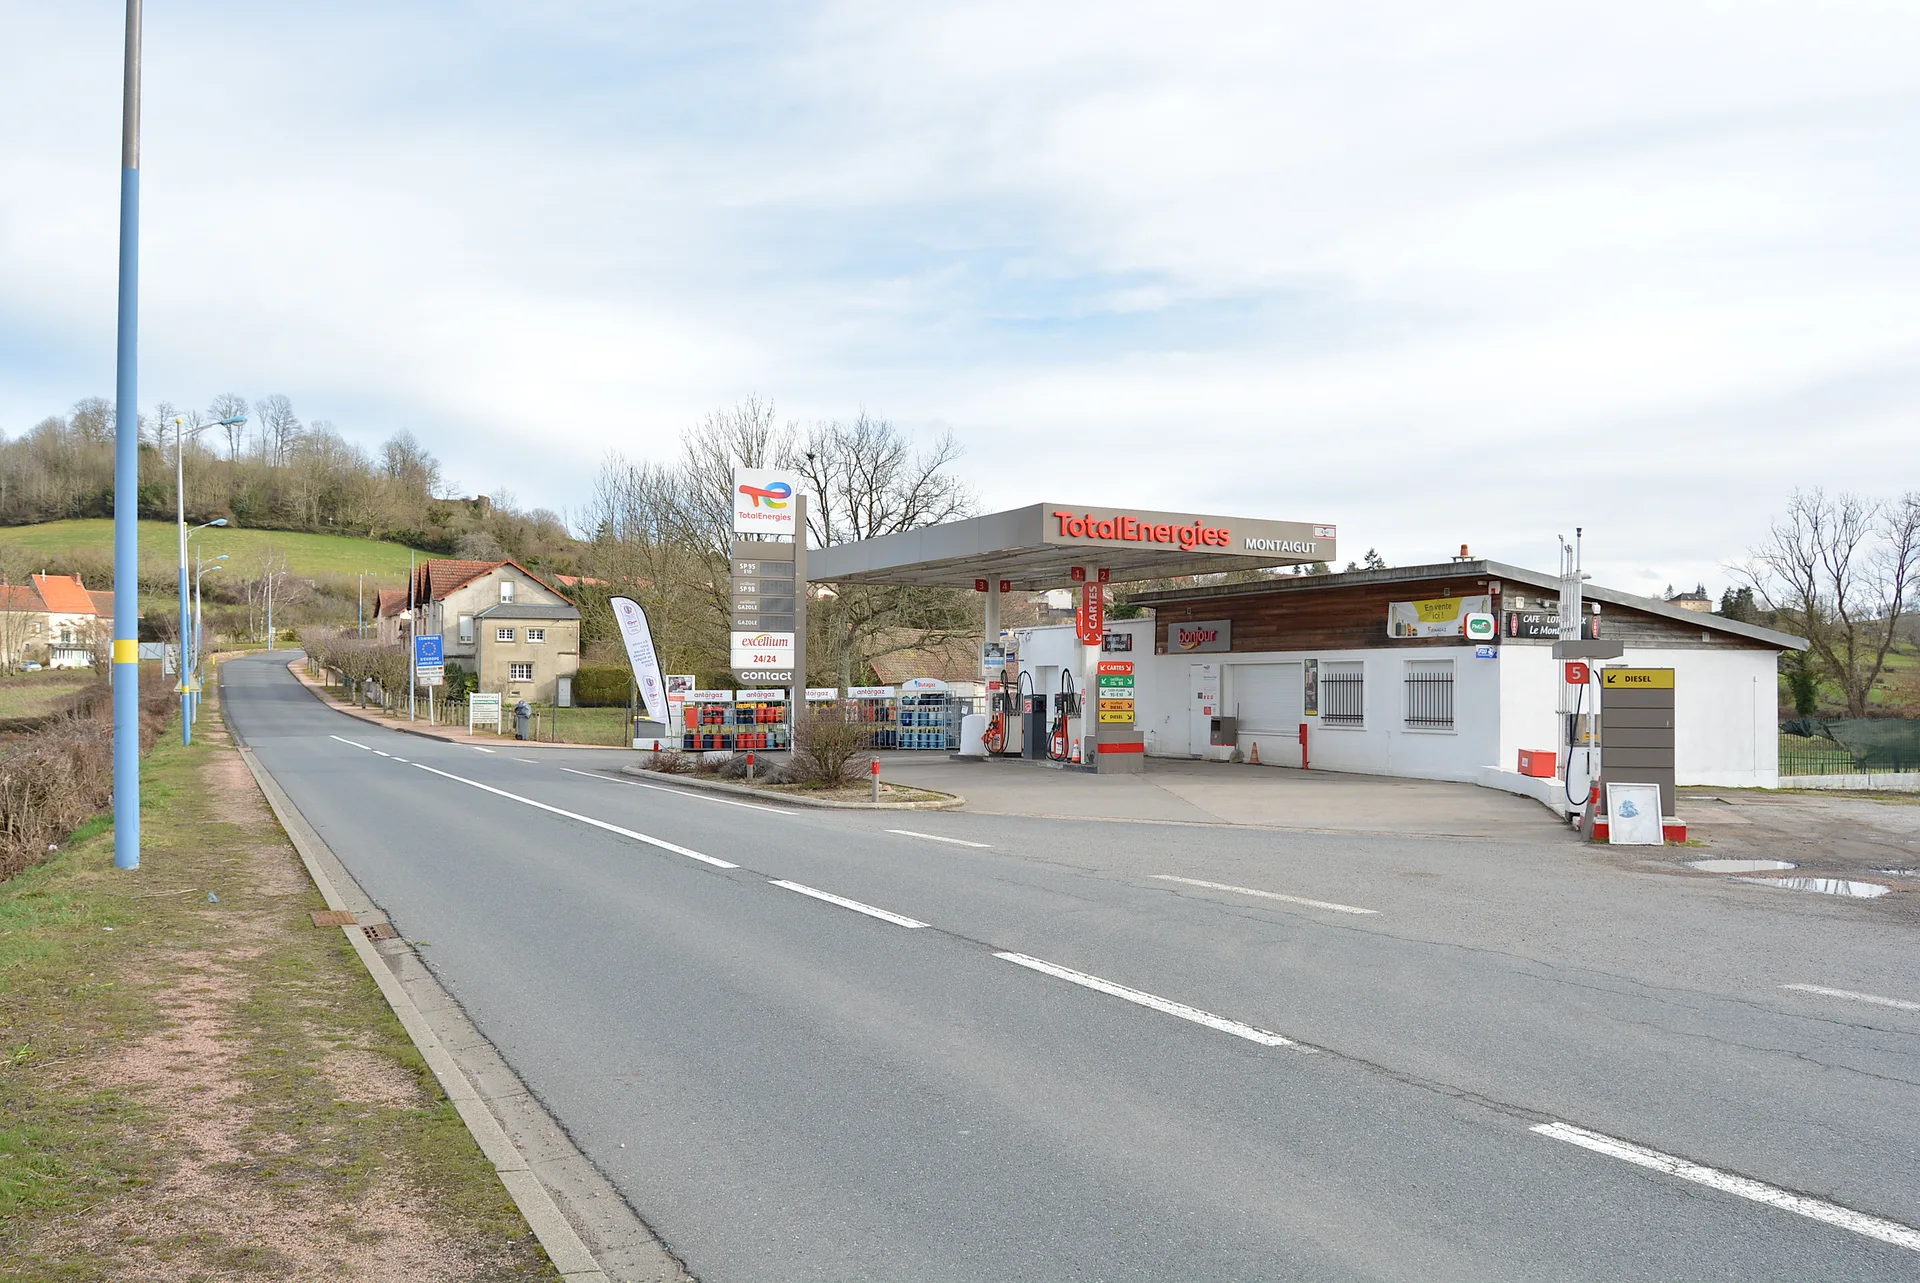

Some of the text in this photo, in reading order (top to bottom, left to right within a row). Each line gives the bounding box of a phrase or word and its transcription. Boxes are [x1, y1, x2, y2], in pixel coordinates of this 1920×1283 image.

[739, 511, 791, 522] TotalEnergies
[1053, 511, 1231, 550] TotalEnergies
[1245, 537, 1316, 554] MONTAIGUT
[1075, 570, 1080, 578] 1
[1100, 571, 1106, 579] 2
[1088, 585, 1098, 630] CARTES
[1434, 602, 1452, 610] vente
[1523, 615, 1540, 623] CAFE
[1529, 625, 1539, 635] Le
[1178, 626, 1217, 646] bonjour
[741, 636, 788, 647] excellium
[753, 654, 777, 663] 24/24
[741, 671, 792, 680] contact
[1572, 666, 1581, 679] 5
[1625, 675, 1652, 683] DIESEL
[857, 688, 885, 696] antargaz
